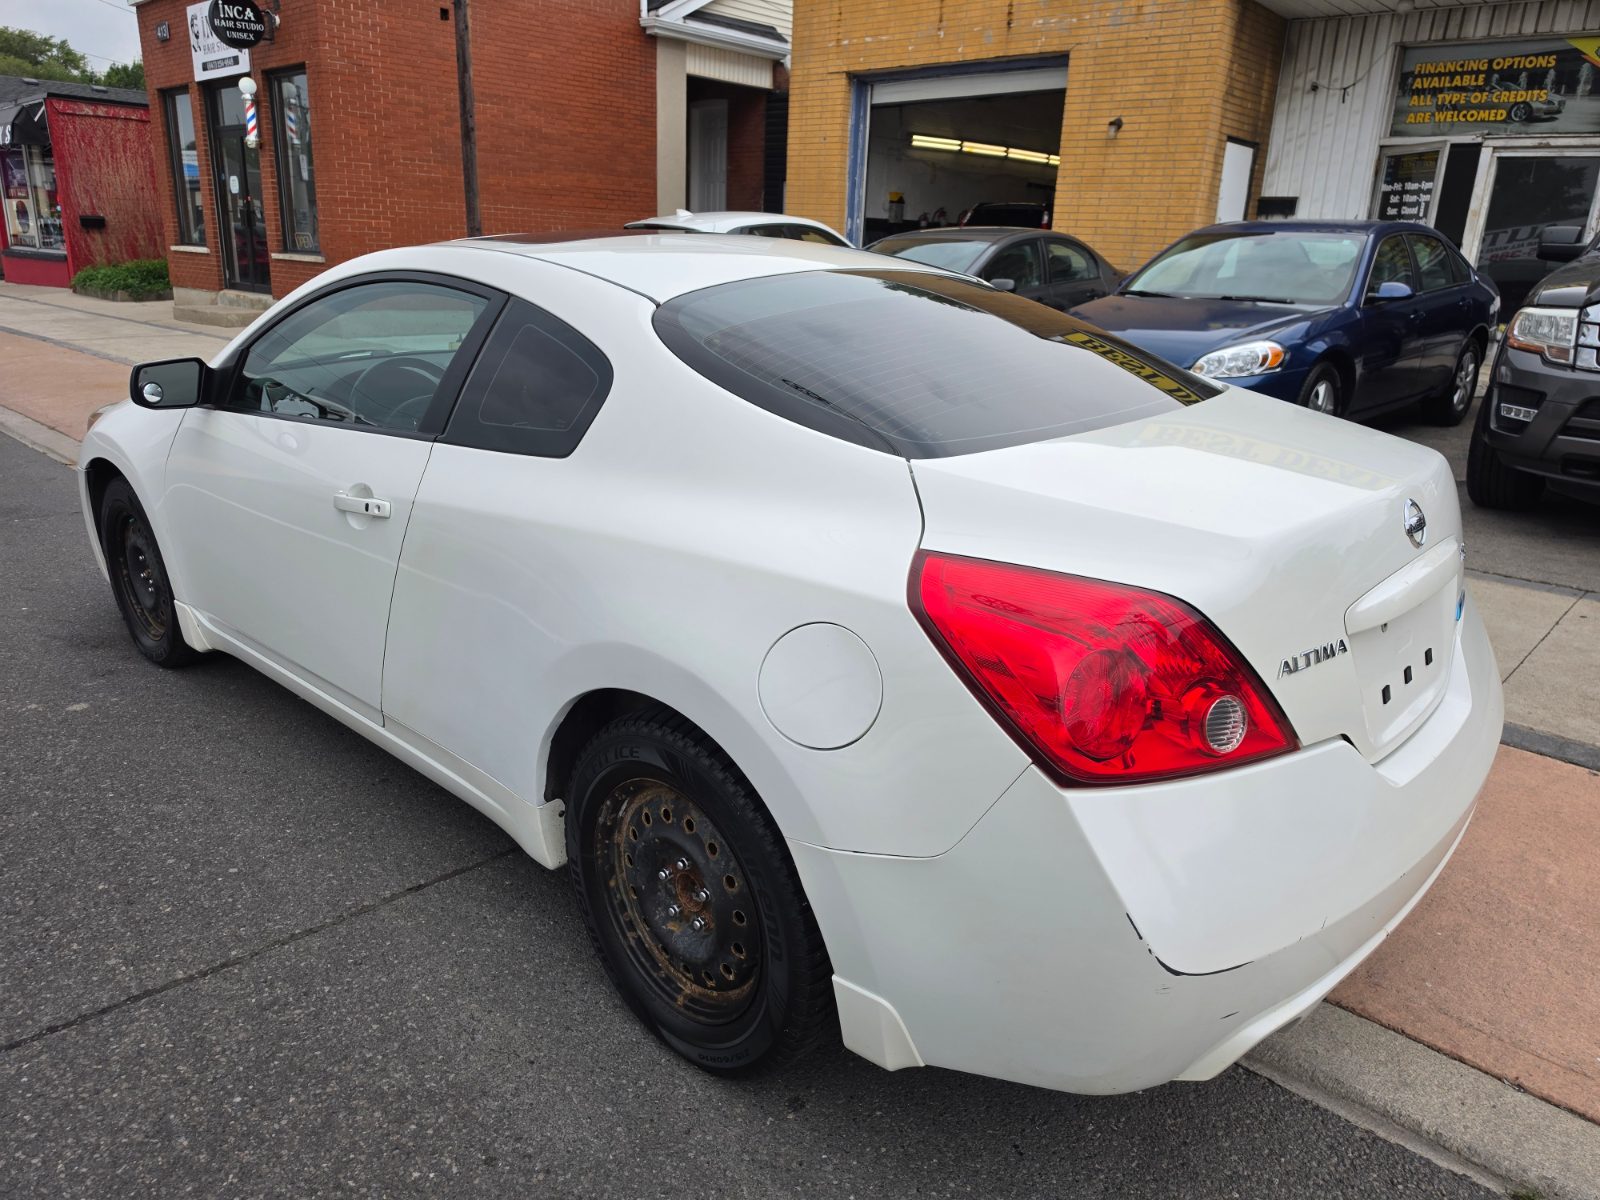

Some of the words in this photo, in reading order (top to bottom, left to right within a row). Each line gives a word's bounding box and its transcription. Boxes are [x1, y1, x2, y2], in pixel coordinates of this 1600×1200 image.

[214, 18, 235, 29] HAIR
[236, 21, 265, 32] STUDIO
[226, 30, 255, 41] UNISEX
[1414, 59, 1488, 75] FINANCING
[1492, 55, 1557, 70] OPTIONS
[1412, 74, 1485, 89] AVAILABLE
[1409, 94, 1433, 106] ALL
[1437, 93, 1466, 105] TYPE
[1470, 92, 1489, 104] OF
[1492, 89, 1548, 103] CREDITS
[1406, 112, 1432, 124] ARE
[1434, 109, 1507, 122] WELCOMED
[1277, 637, 1349, 680] ALTIMA
